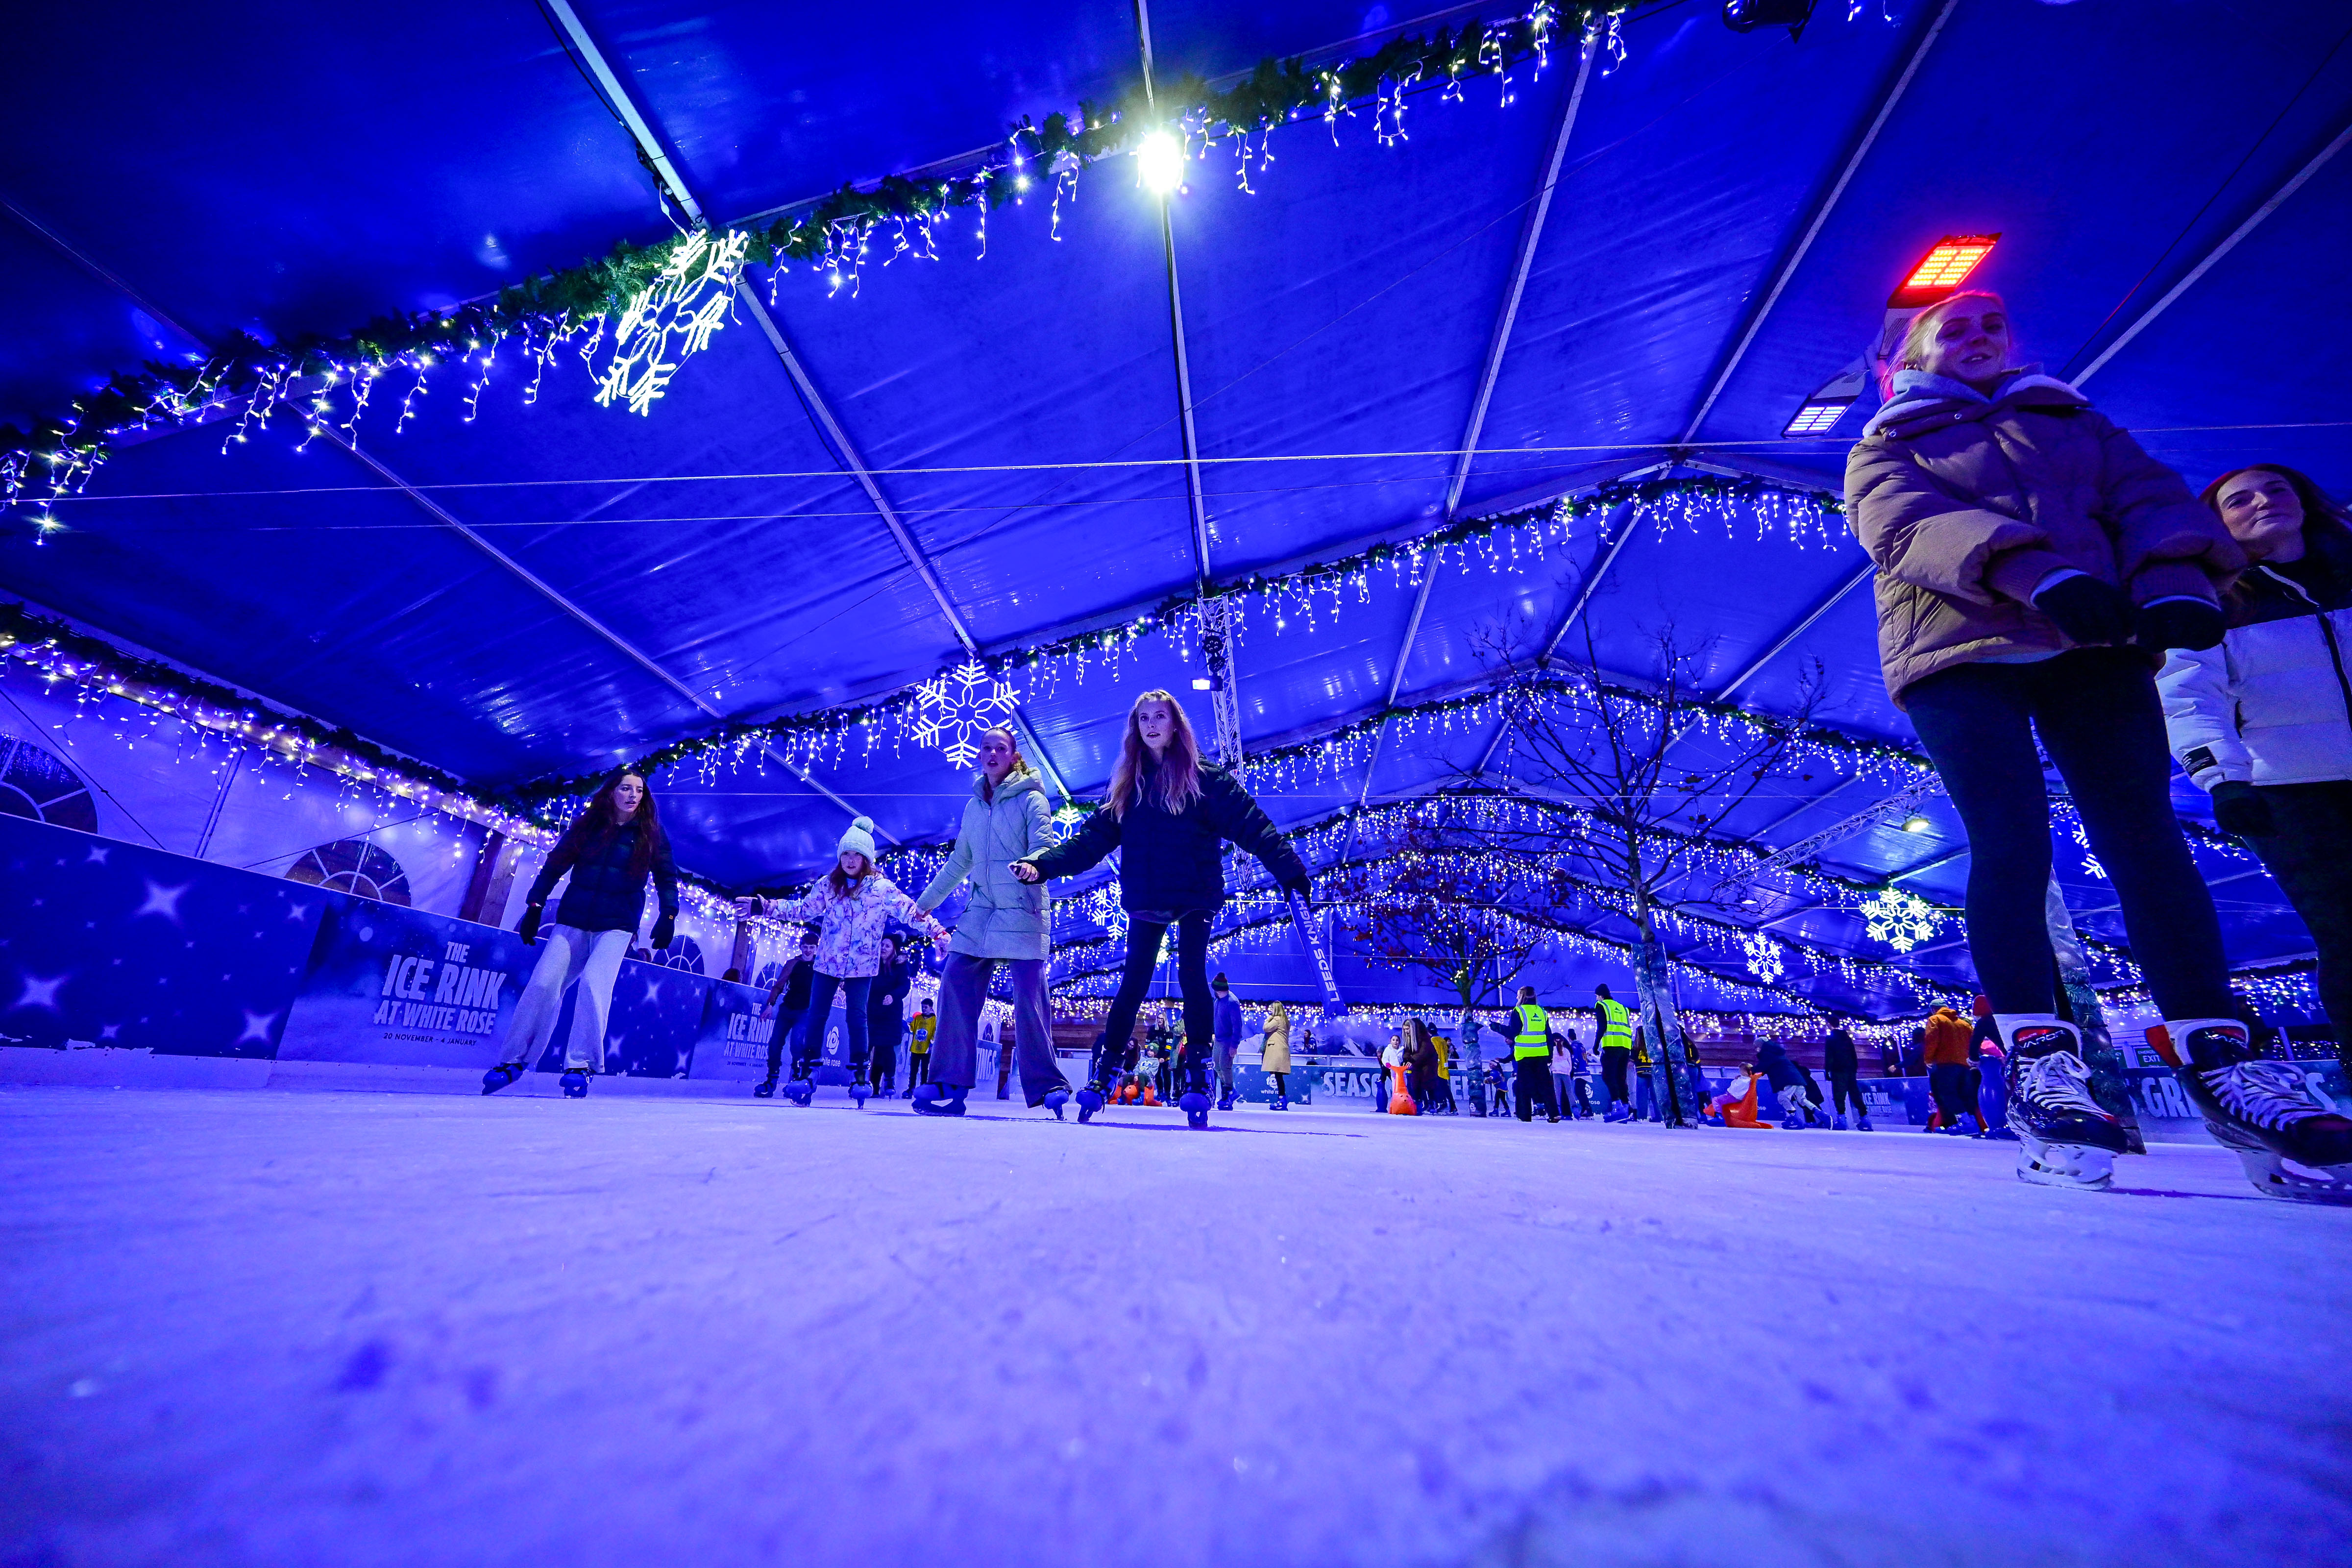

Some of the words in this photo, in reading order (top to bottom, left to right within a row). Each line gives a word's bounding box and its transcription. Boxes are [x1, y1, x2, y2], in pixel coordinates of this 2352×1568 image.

[444, 941, 470, 963] THE
[381, 954, 435, 1001] ICE
[434, 963, 507, 1010] RINK
[1313, 948, 1340, 1002] LEEDS
[373, 1000, 402, 1025] AT
[403, 1002, 456, 1031] WHITE
[455, 1008, 496, 1036] ROSE
[752, 1002, 762, 1016] THE
[727, 1012, 748, 1041] ICE
[394, 1033, 434, 1043] NOVEMBER
[446, 1037, 477, 1047] JANUARY
[724, 1041, 735, 1056] AT
[735, 1042, 756, 1059] WHITE
[755, 1044, 769, 1060] ROS
[2142, 1054, 2160, 1063] EXIT
[831, 1059, 841, 1067] rose
